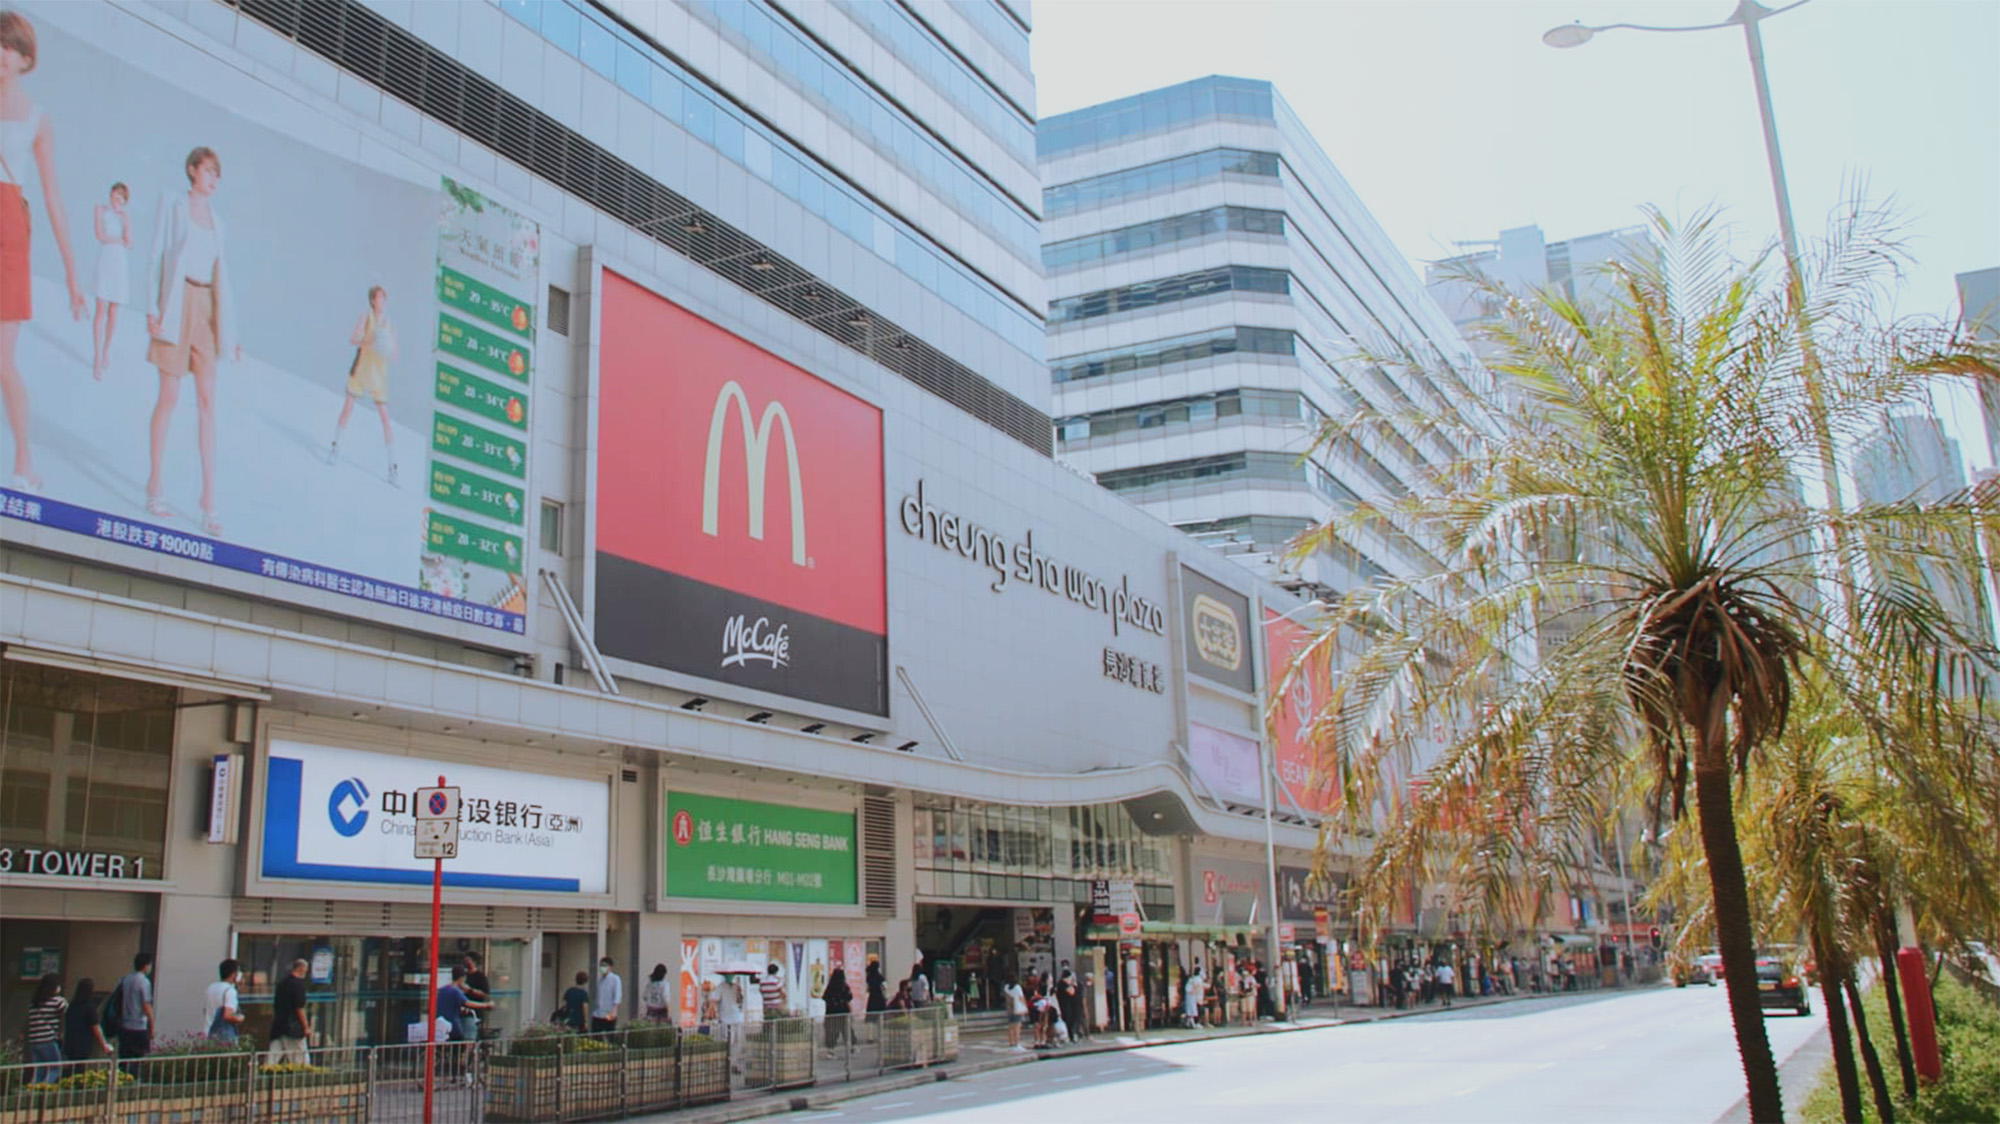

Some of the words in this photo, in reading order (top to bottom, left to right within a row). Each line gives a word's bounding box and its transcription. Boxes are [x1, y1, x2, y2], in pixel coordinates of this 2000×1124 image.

[901, 478, 1007, 593] cheung
[1014, 529, 1060, 595] sha
[1064, 566, 1108, 614] wan
[1112, 574, 1165, 637] plaza
[443, 821, 450, 833] 7
[495, 831, 523, 846] Bank
[764, 828, 793, 847] HANG
[795, 831, 821, 849] SENG
[823, 833, 849, 852] BANK
[442, 842, 454, 855] 12
[24, 849, 124, 878] TOWER
[133, 857, 144, 879] 1
